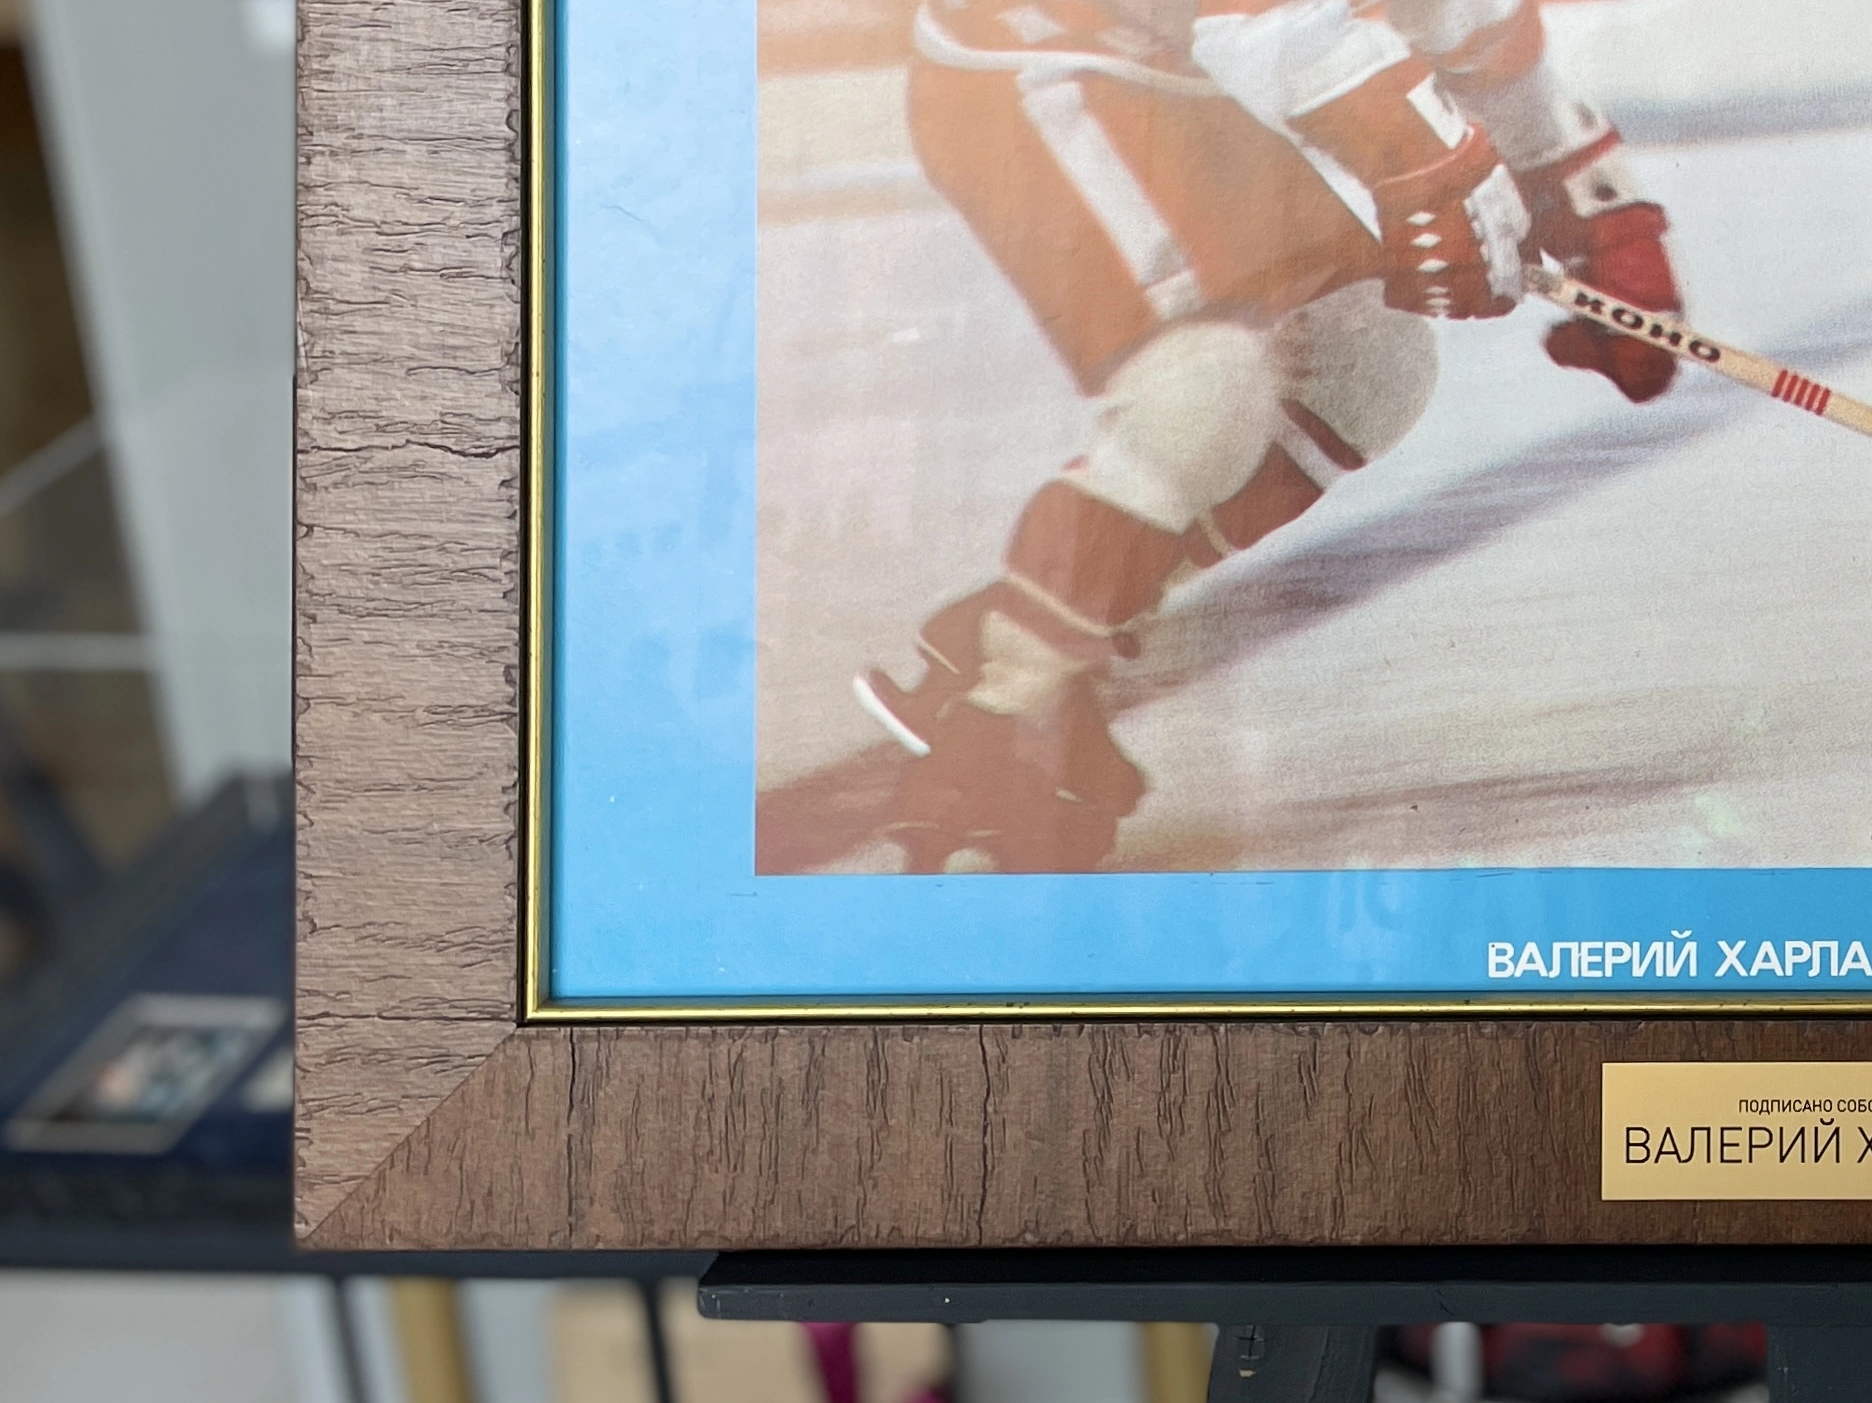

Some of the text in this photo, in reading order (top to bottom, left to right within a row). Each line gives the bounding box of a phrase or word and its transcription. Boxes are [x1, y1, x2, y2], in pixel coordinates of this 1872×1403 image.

[1573, 292, 1721, 363] KOHO
[1487, 930, 1697, 978] ВАЛЕРИЙ
[1738, 1098, 1833, 1115] ПОДПИСАНО
[1625, 1119, 1841, 1164] ВАЛЕРИЙ
